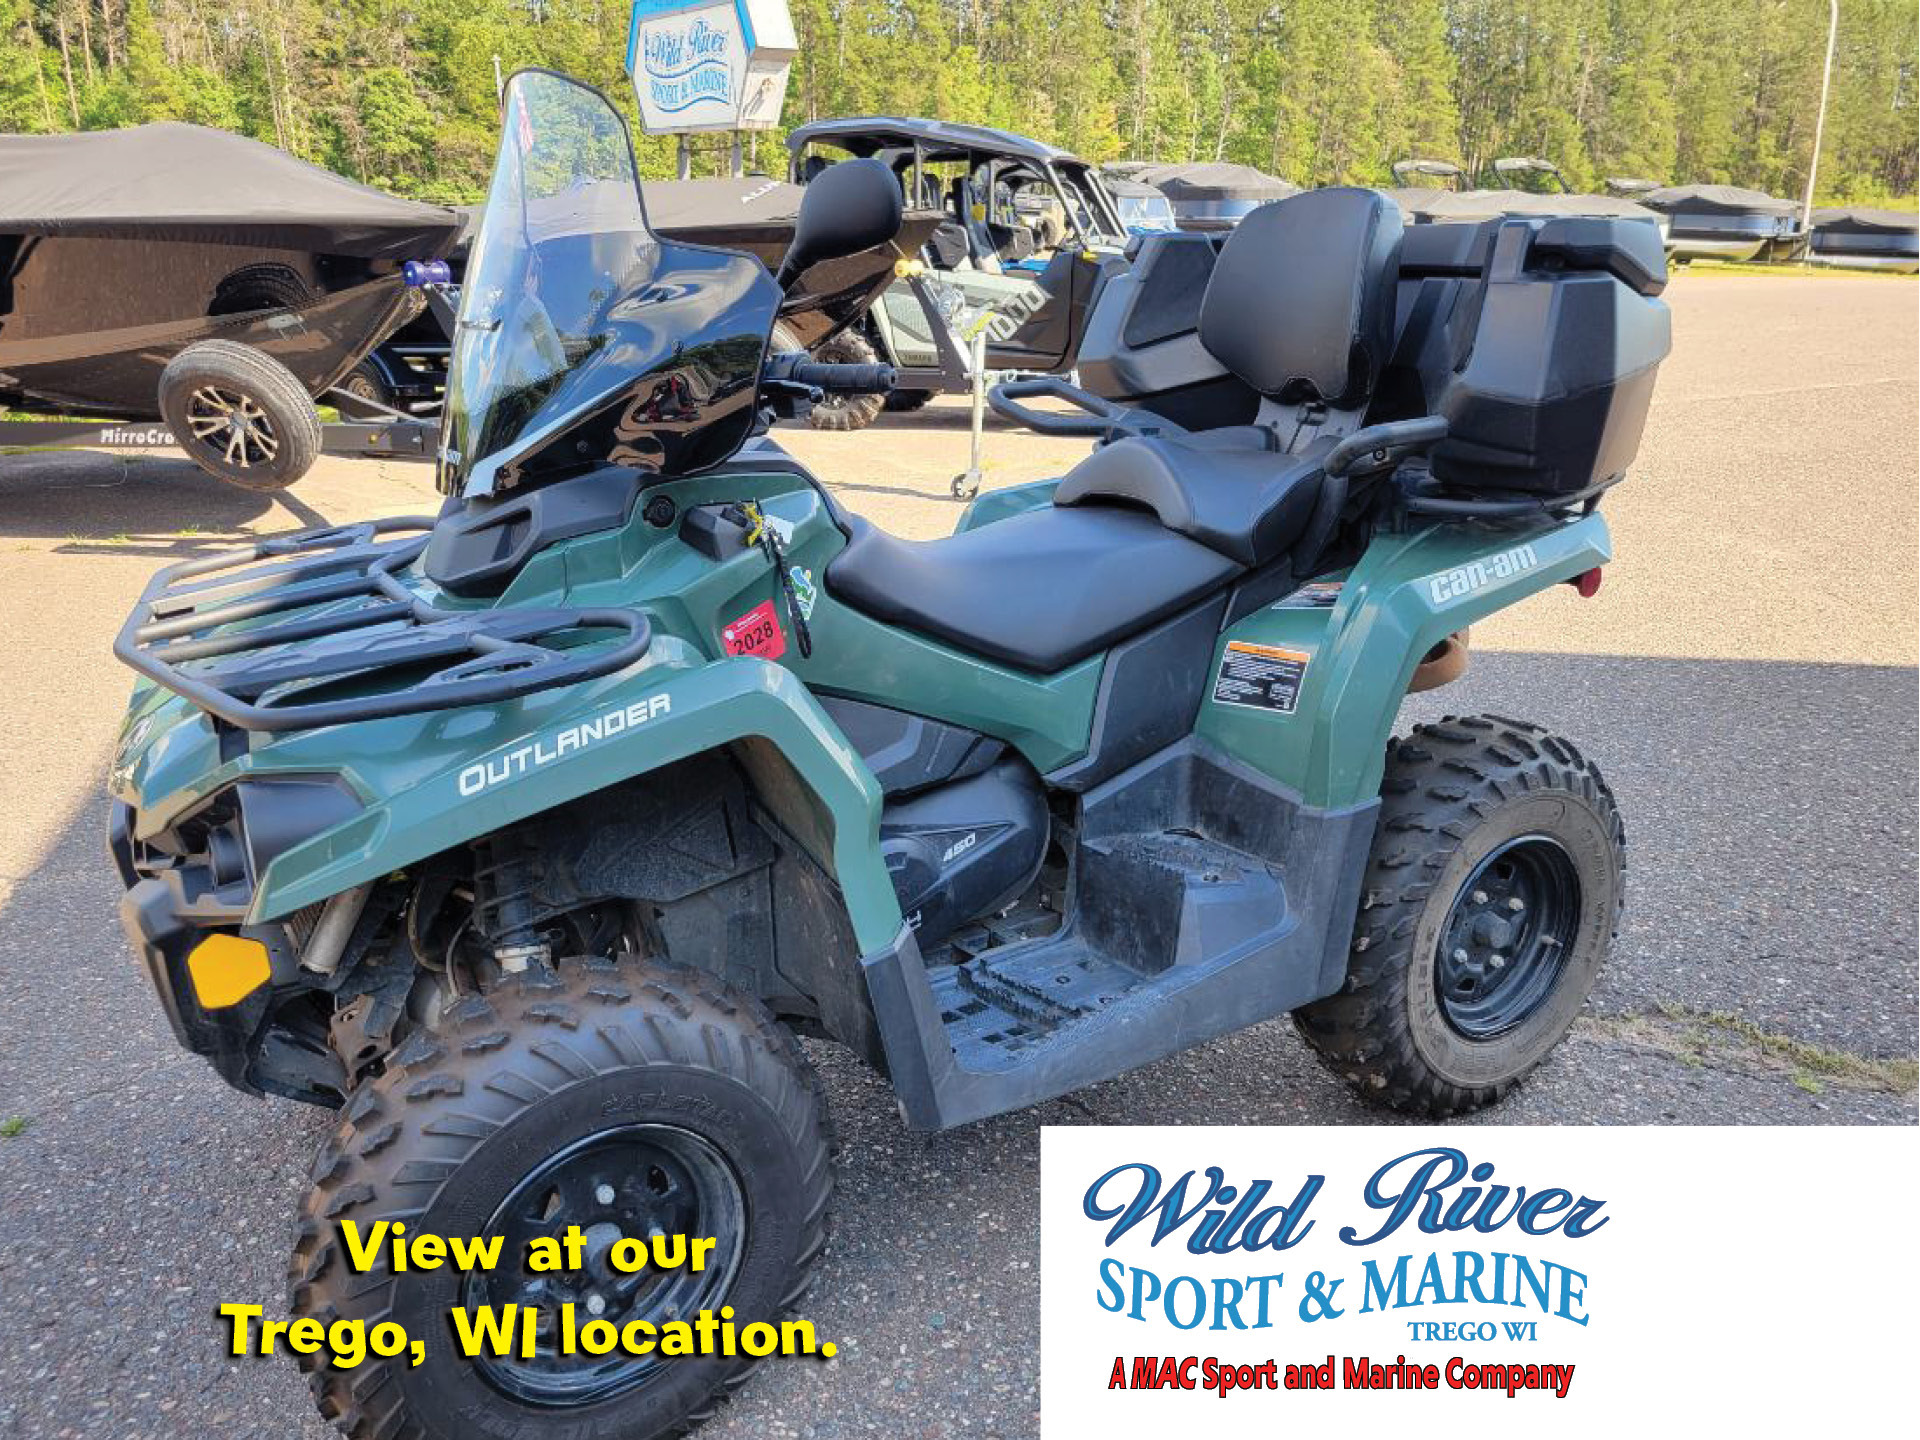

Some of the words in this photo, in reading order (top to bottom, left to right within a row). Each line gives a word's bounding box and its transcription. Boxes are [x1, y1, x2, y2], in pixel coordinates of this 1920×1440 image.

[645, 28, 684, 68] Wild
[687, 19, 729, 60] River
[984, 284, 1047, 342] 1000
[733, 620, 774, 656] 2028
[459, 693, 671, 796] OUTLANDER
[943, 831, 976, 862] 450
